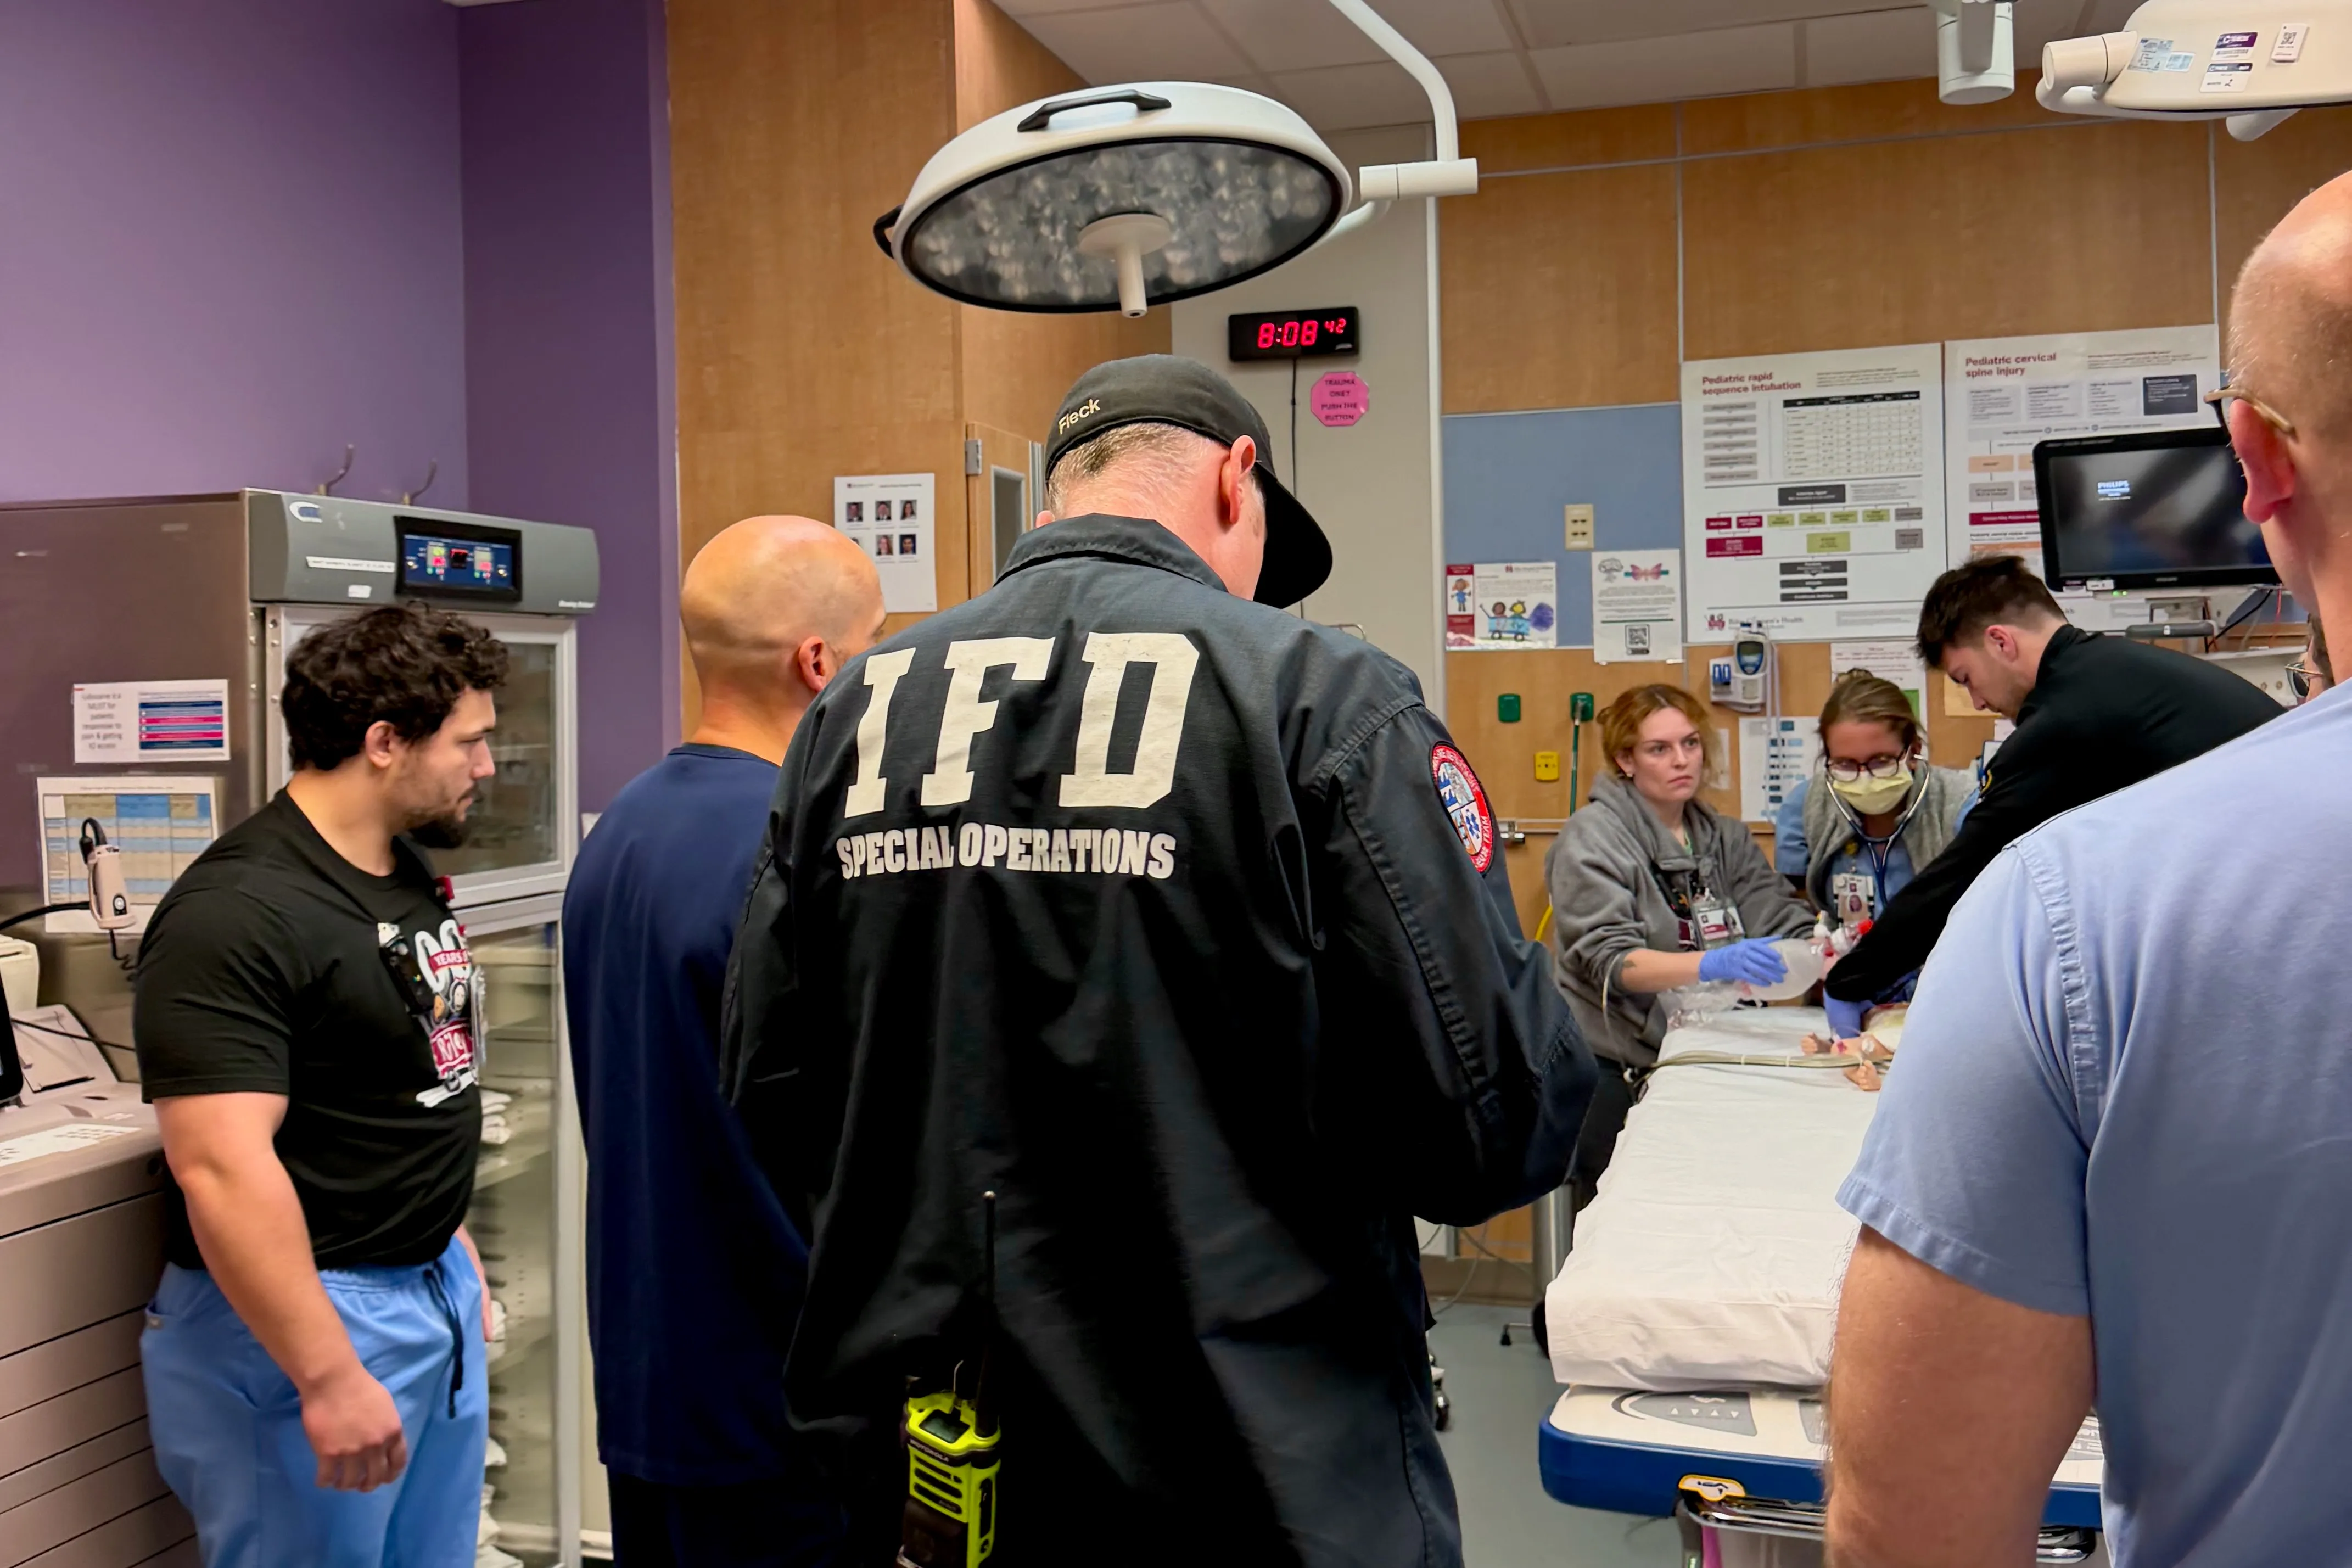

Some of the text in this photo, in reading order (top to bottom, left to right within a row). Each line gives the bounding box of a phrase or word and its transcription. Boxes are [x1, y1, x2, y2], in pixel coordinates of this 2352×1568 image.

[1257, 318, 1347, 349] 8:08 42
[1965, 352, 2057, 366] Pediatric cervical
[1702, 372, 1773, 385] Pediatric rapid
[1965, 367, 2025, 378] spine injury
[1702, 382, 1802, 395] sequence intubation
[1058, 399, 1101, 435] Fleck
[845, 632, 1200, 819] IFD
[836, 822, 1177, 879] SPECIAL OPERATIONS
